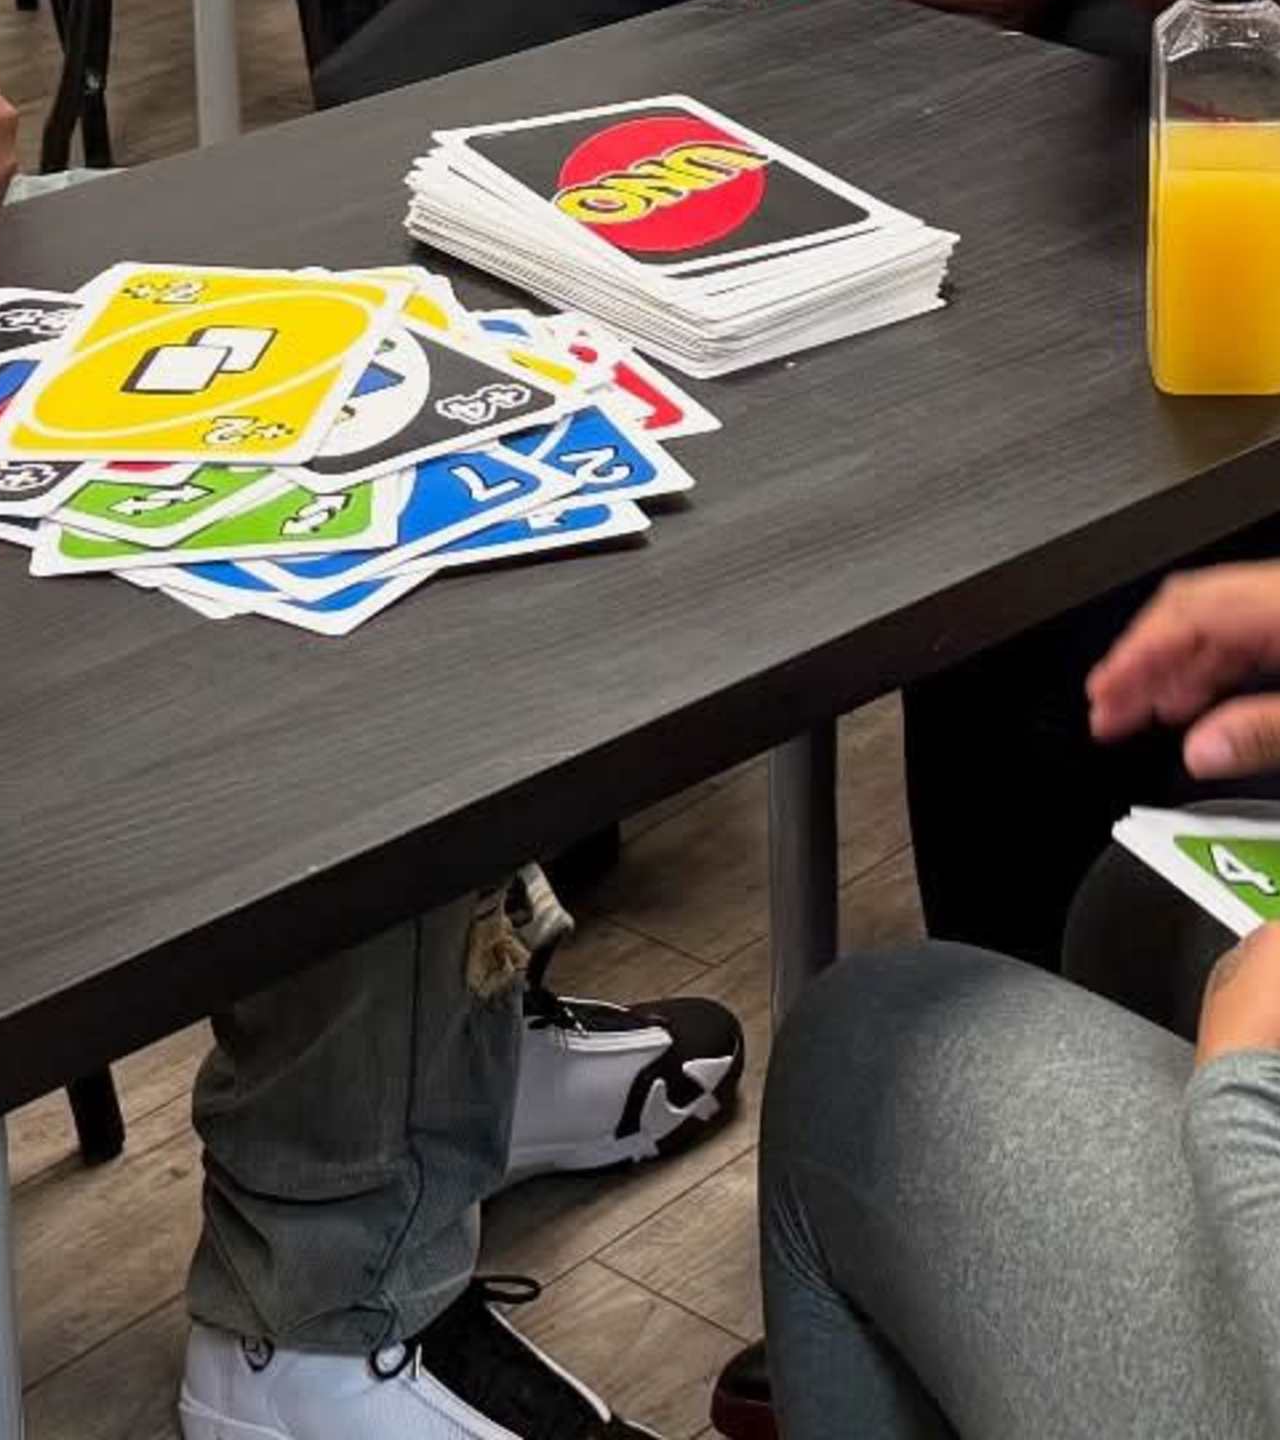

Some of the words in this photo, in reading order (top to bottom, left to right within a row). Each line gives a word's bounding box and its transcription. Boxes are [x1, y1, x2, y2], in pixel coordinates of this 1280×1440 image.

[553, 140, 769, 224] UNO
[558, 445, 635, 485] 2
[1209, 844, 1280, 896] 4
